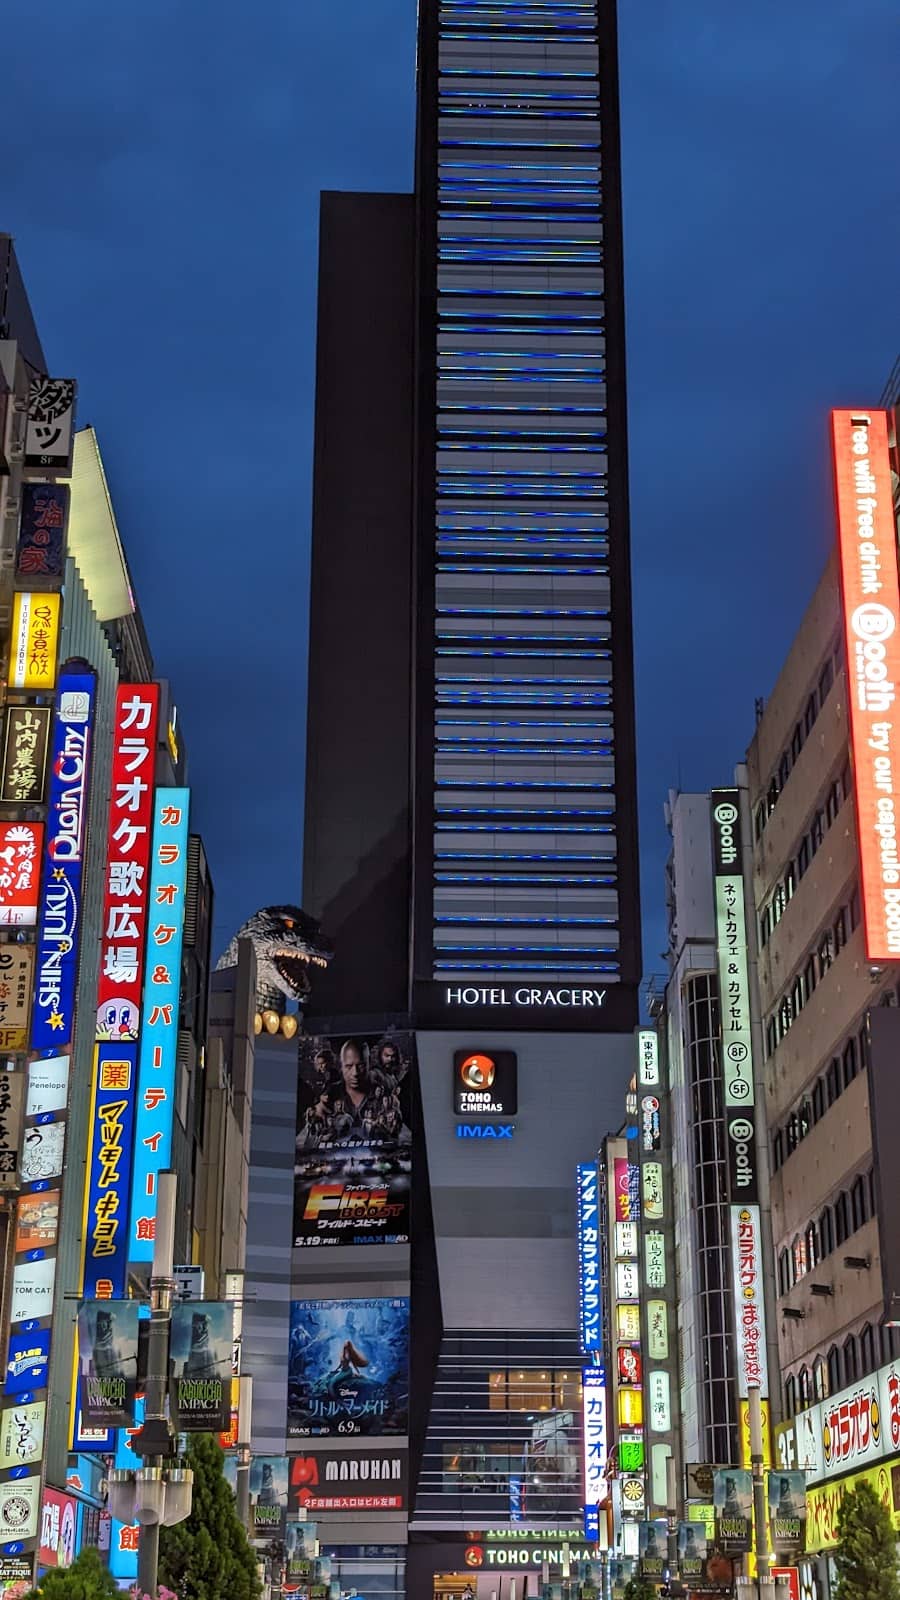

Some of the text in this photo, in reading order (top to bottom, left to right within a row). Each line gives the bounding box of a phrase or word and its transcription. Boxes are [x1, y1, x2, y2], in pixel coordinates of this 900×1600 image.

[857, 497, 877, 539] free
[860, 542, 882, 594] drink
[9, 710, 41, 789] 山内農場
[59, 726, 86, 782] City
[866, 722, 893, 752] try
[873, 756, 893, 793] our
[15, 789, 30, 799] 5F
[103, 695, 152, 984] カラオケ歌広場
[715, 803, 738, 869] Booth
[875, 797, 899, 884] capsule
[724, 883, 741, 960] ネットカフェ
[39, 884, 70, 1006] SHINJUKU
[447, 988, 606, 1006] HOTEL GRACERY
[728, 981, 743, 1032] カプセル
[103, 1066, 130, 1087] 薬
[460, 1093, 491, 1104] TOHO
[460, 1103, 503, 1112] CINEMAS
[456, 1124, 512, 1139] IMAX
[730, 1118, 754, 1188] Booth
[93, 1099, 129, 1257] マツモトキヨシ
[303, 1183, 388, 1220] FIRE
[341, 1203, 405, 1218] BOOST
[295, 1236, 321, 1246] 5.19
[739, 1223, 758, 1286] カラオケ
[88, 1397, 125, 1407] IMPACT
[178, 1398, 221, 1409] IMPACT
[309, 1398, 389, 1418] リトル・マーメイド
[338, 1420, 355, 1434] 6.9
[587, 1397, 606, 1481] カラオケ
[828, 1393, 871, 1457] カラオケ
[325, 1459, 401, 1481] MARUHAN
[587, 1483, 605, 1493] 747
[487, 1549, 530, 1564] TOHO
